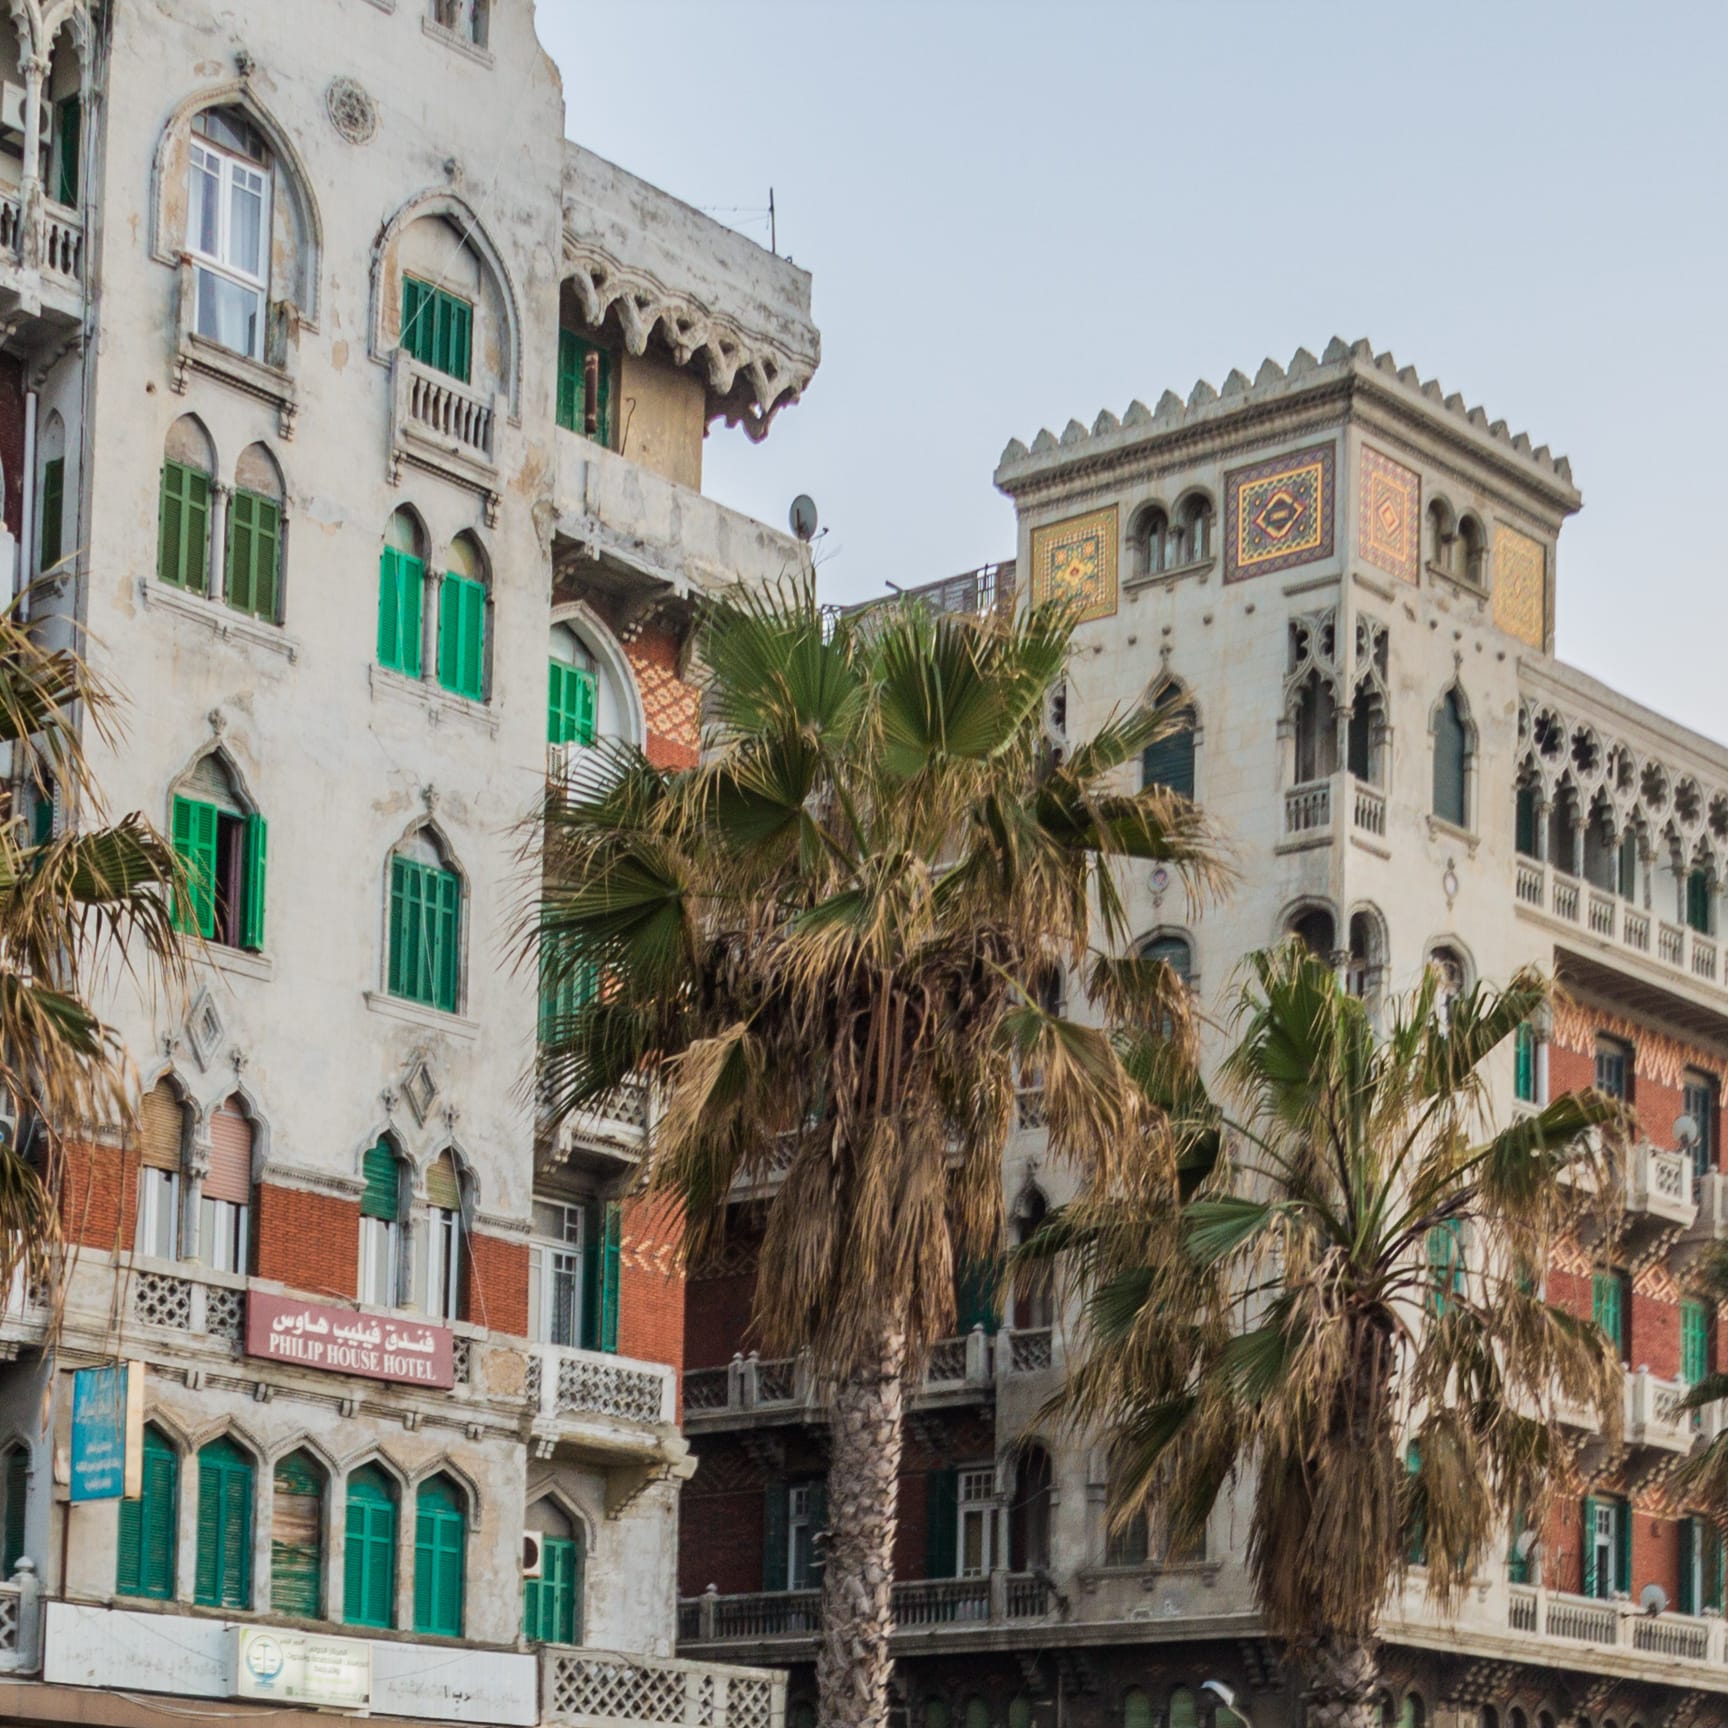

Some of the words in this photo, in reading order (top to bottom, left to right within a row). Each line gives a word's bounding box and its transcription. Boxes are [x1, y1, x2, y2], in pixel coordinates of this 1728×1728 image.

[272, 1311, 329, 1335] هاوس
[332, 1319, 382, 1349] فيليب
[384, 1324, 436, 1353] فندق
[269, 1332, 323, 1361] PHILIP
[327, 1343, 379, 1372] HOUSE
[383, 1354, 437, 1381] HOTEL
